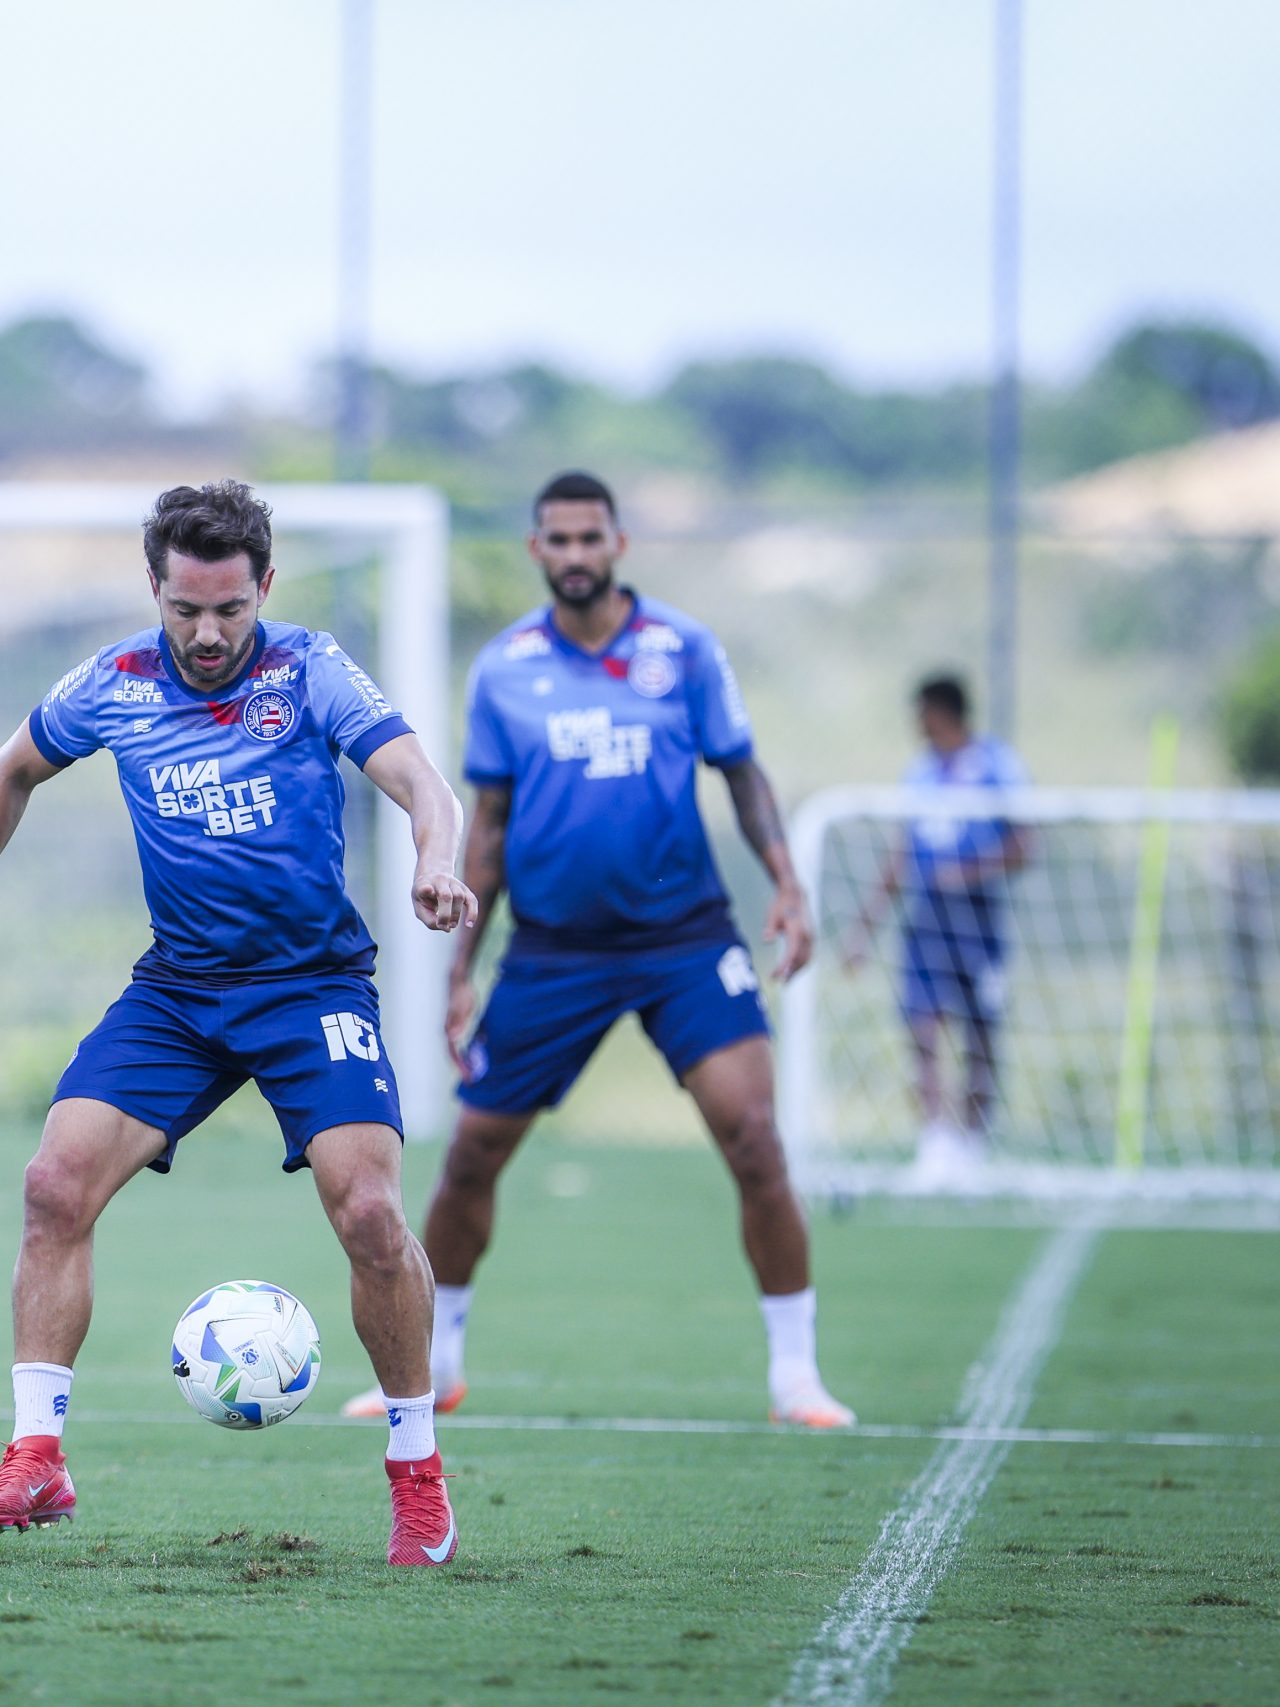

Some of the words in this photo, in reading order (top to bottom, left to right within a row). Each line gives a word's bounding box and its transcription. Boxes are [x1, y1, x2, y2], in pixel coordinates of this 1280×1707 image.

[124, 679, 155, 693] VIVA
[261, 664, 290, 681] VIVA
[113, 689, 163, 703] SORTE
[247, 698, 262, 730] ESPORTE
[261, 694, 286, 705] CLUBE
[281, 705, 291, 727] BAHIA
[346, 676, 381, 719] Alimentos
[262, 730, 276, 738] 1931
[148, 759, 222, 793] VIVA
[155, 775, 275, 818] SORTE
[203, 798, 277, 837] .BET
